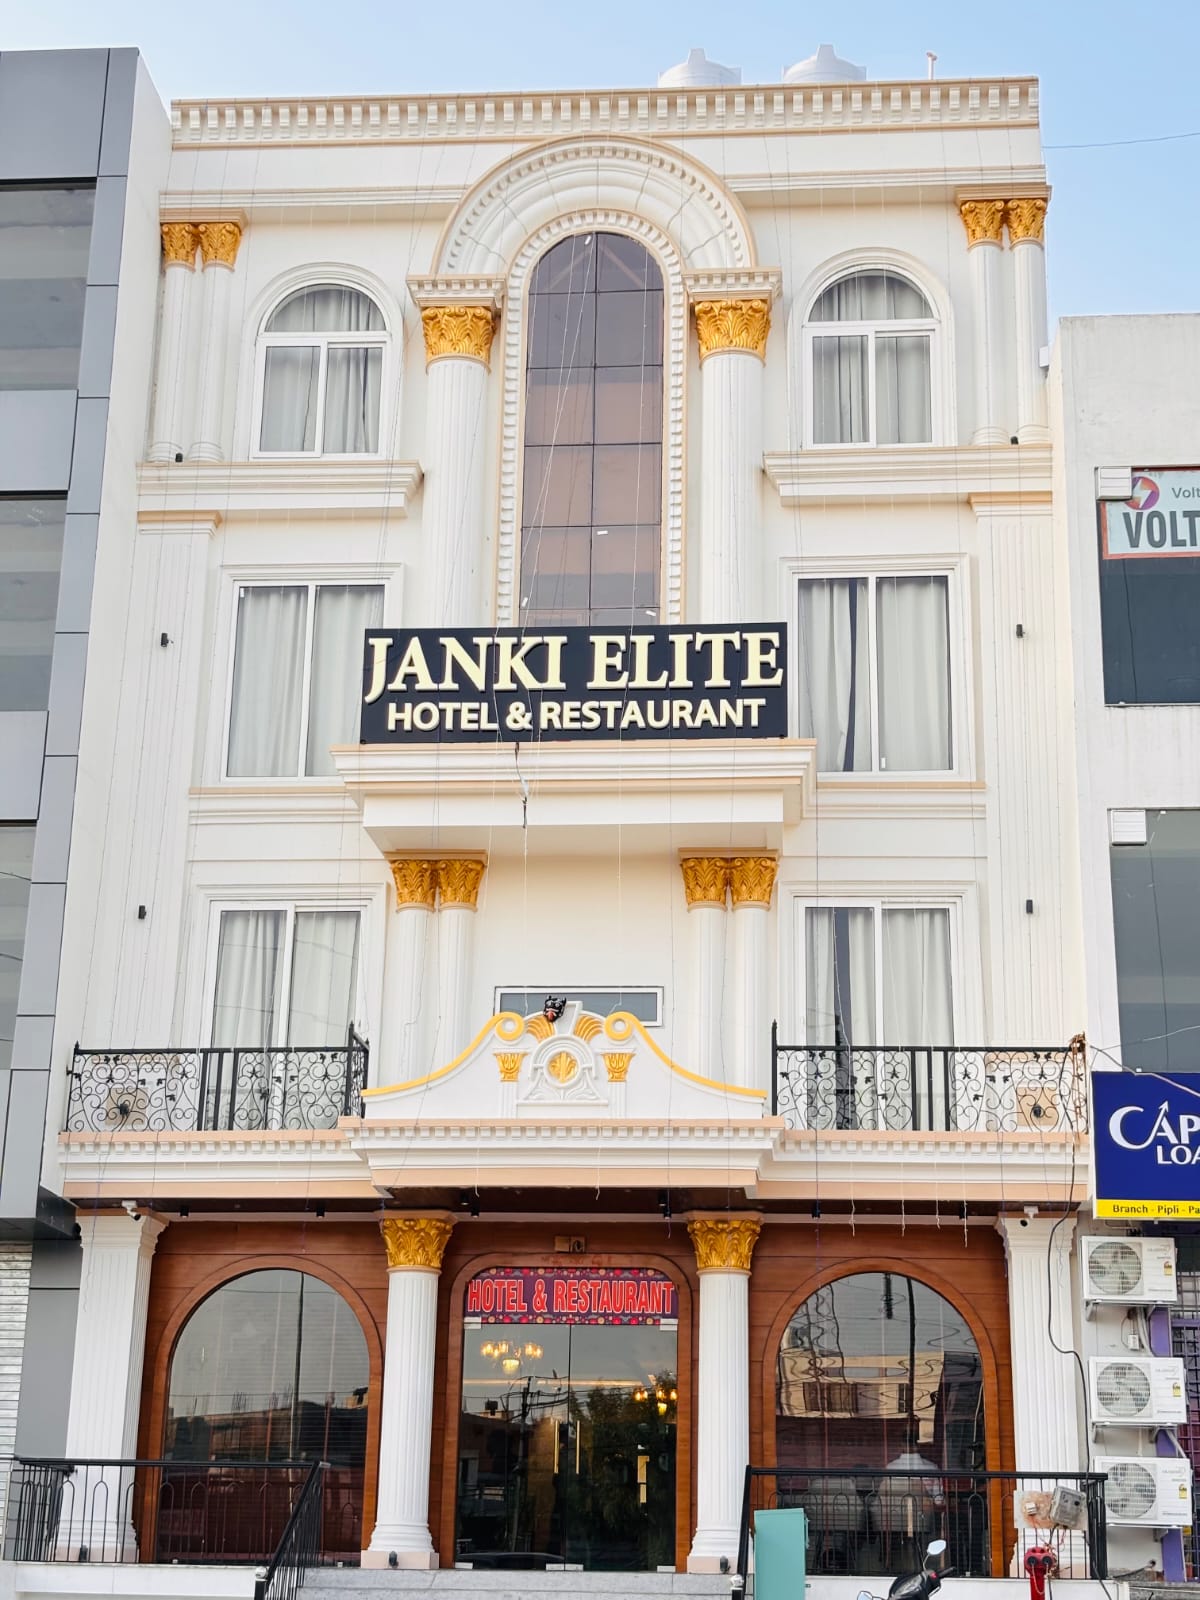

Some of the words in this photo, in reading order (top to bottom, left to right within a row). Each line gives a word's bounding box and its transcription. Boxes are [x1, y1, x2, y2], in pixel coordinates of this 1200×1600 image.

[1171, 487, 1200, 498] Volt
[1122, 510, 1200, 548] VOLT
[365, 635, 568, 702] JANKI
[586, 631, 784, 690] ELITE
[387, 702, 498, 731] HOTEL
[505, 701, 533, 731] &
[540, 698, 767, 731] RESTAURANT
[1109, 1100, 1200, 1149] CAP
[1112, 1204, 1148, 1213] Branch
[1157, 1205, 1179, 1215] Pipli
[467, 1279, 528, 1312] HOTEL
[532, 1279, 547, 1312] &
[553, 1280, 675, 1314] RESTAURANT
